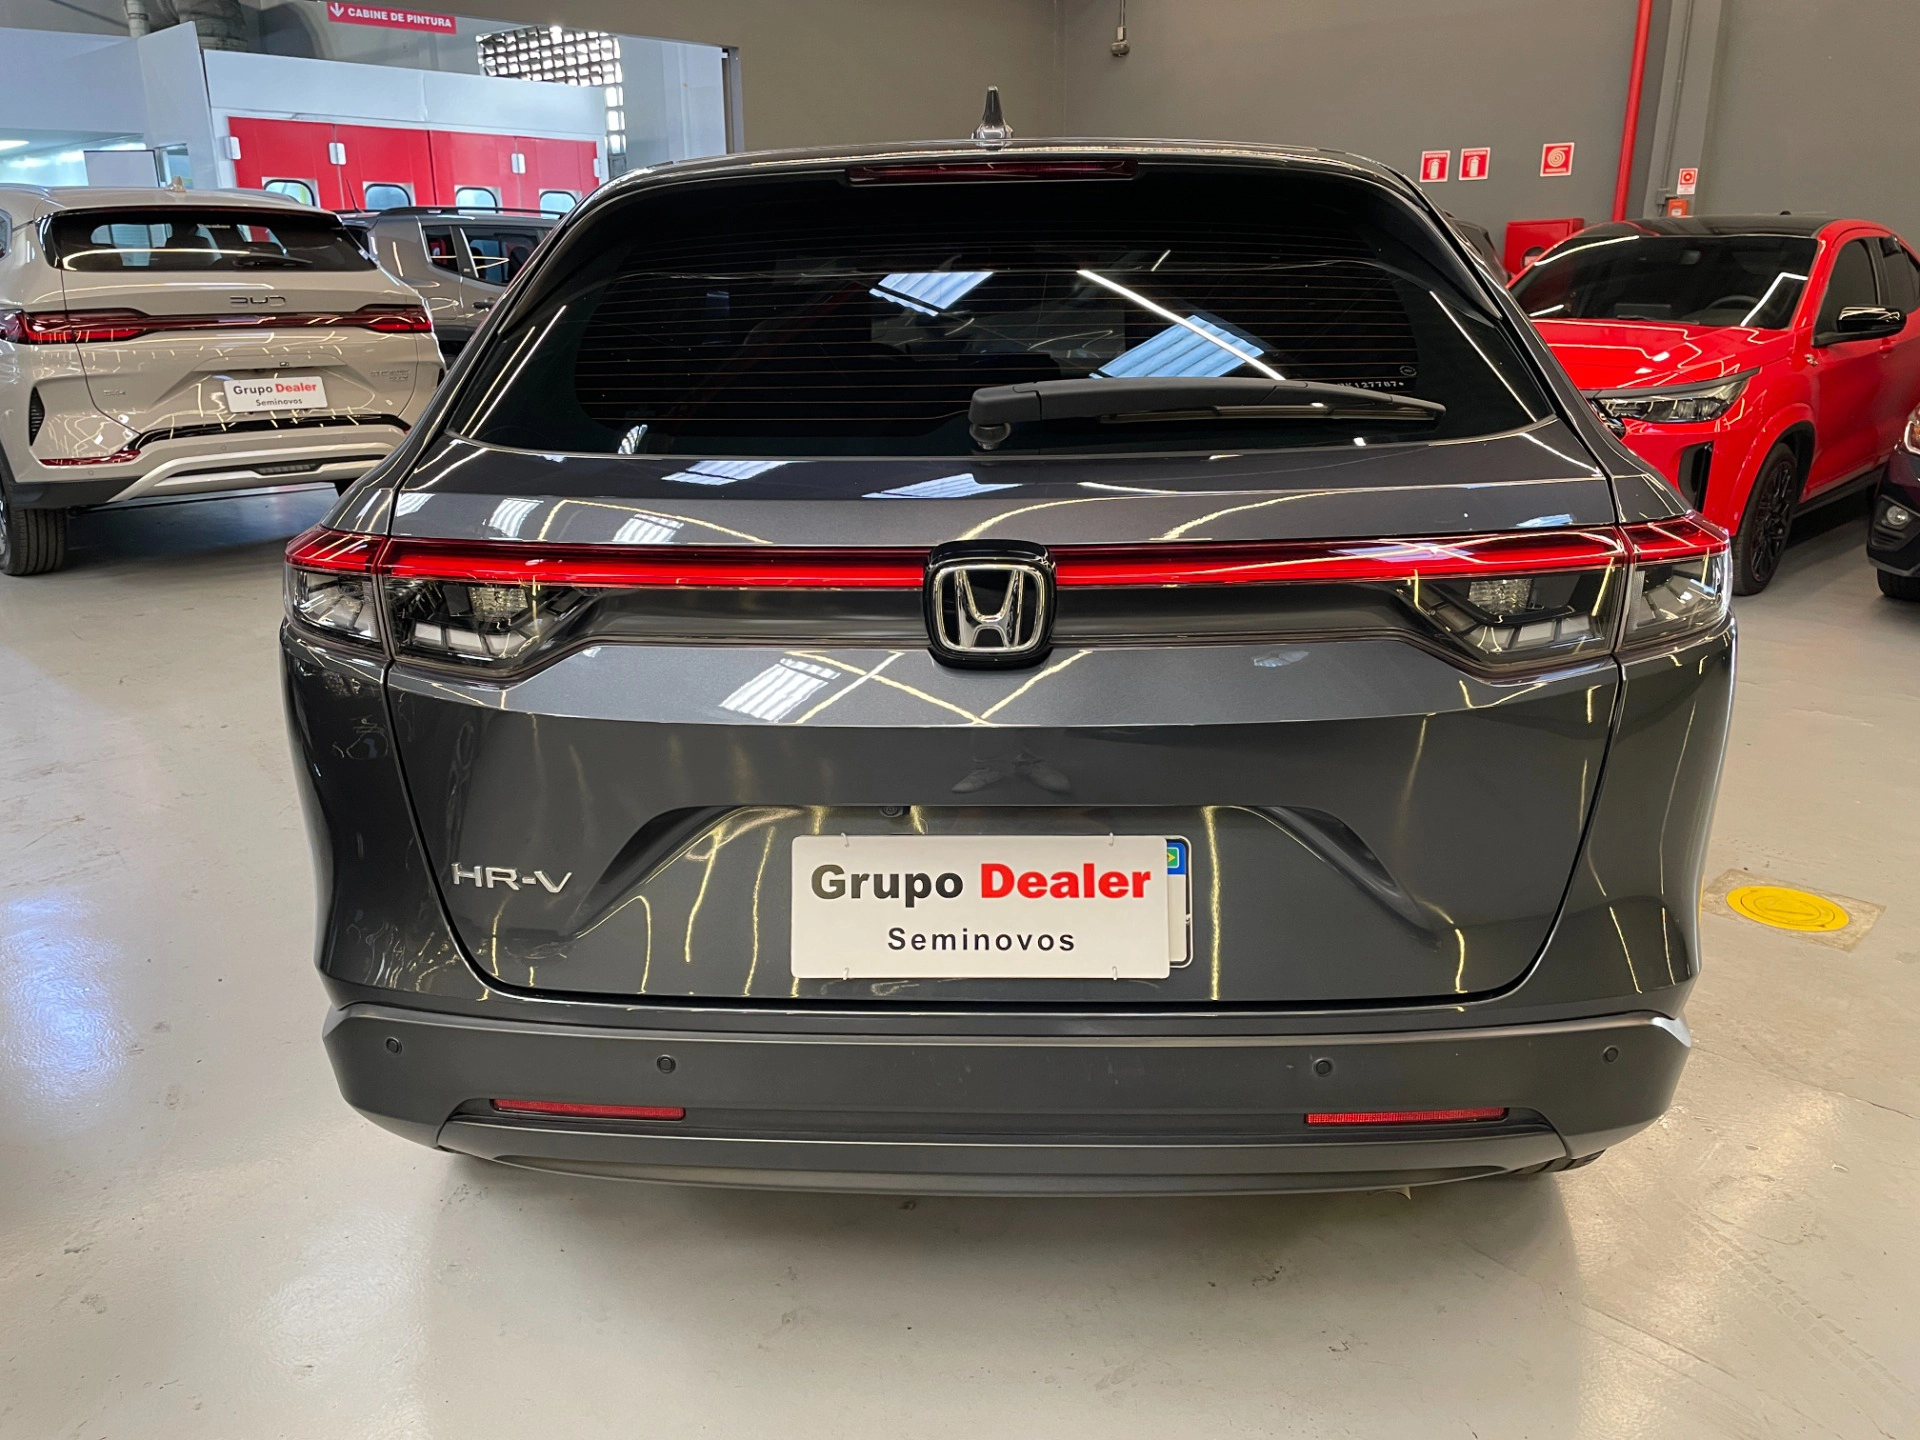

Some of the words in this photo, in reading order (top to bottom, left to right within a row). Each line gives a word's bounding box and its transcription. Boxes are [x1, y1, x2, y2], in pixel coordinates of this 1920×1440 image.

[348, 8, 388, 20] CABINE
[390, 12, 405, 22] DE
[407, 14, 452, 27] PINTURA
[233, 385, 273, 395] Grupo
[275, 383, 317, 393] Dealer
[255, 398, 303, 407] Seminovos
[451, 862, 573, 893] HR-V
[811, 863, 964, 908] Grupo
[980, 862, 1151, 899] Dealer
[887, 927, 1076, 952] Seminovos
